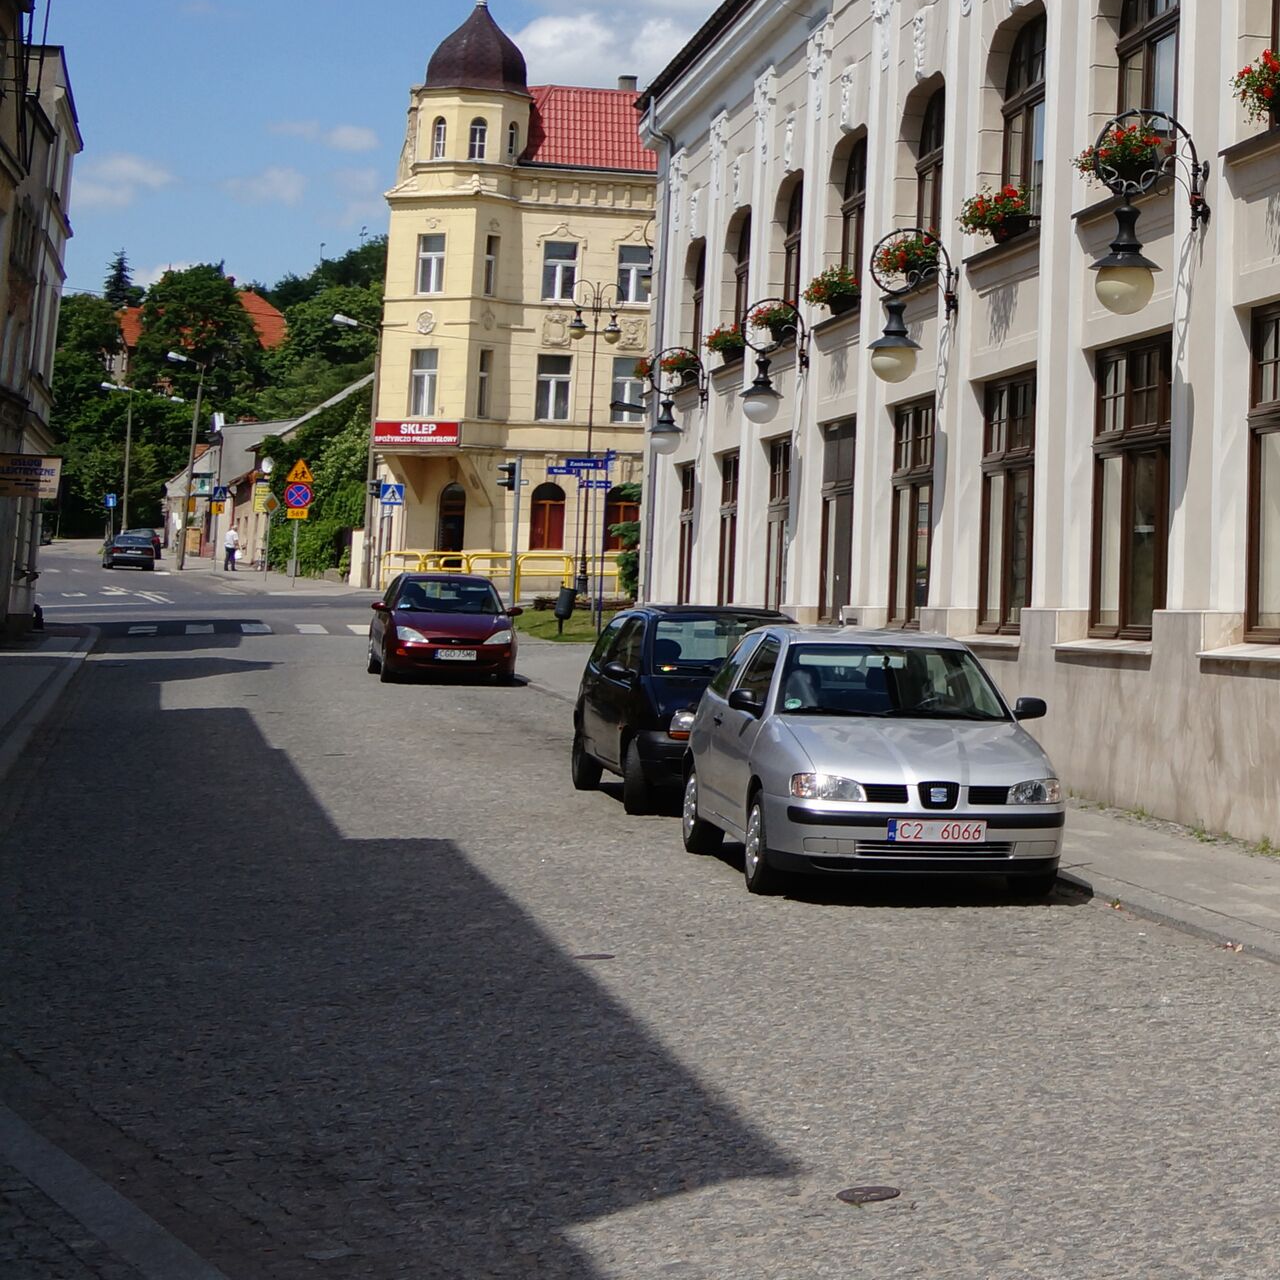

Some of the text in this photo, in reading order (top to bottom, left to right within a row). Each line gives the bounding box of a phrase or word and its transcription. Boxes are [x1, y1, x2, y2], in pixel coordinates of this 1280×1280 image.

[400, 423, 436, 434] SKLEP
[375, 434, 411, 442] SPOŻYWCZO
[900, 822, 923, 839] C2
[941, 823, 982, 840] 6066
